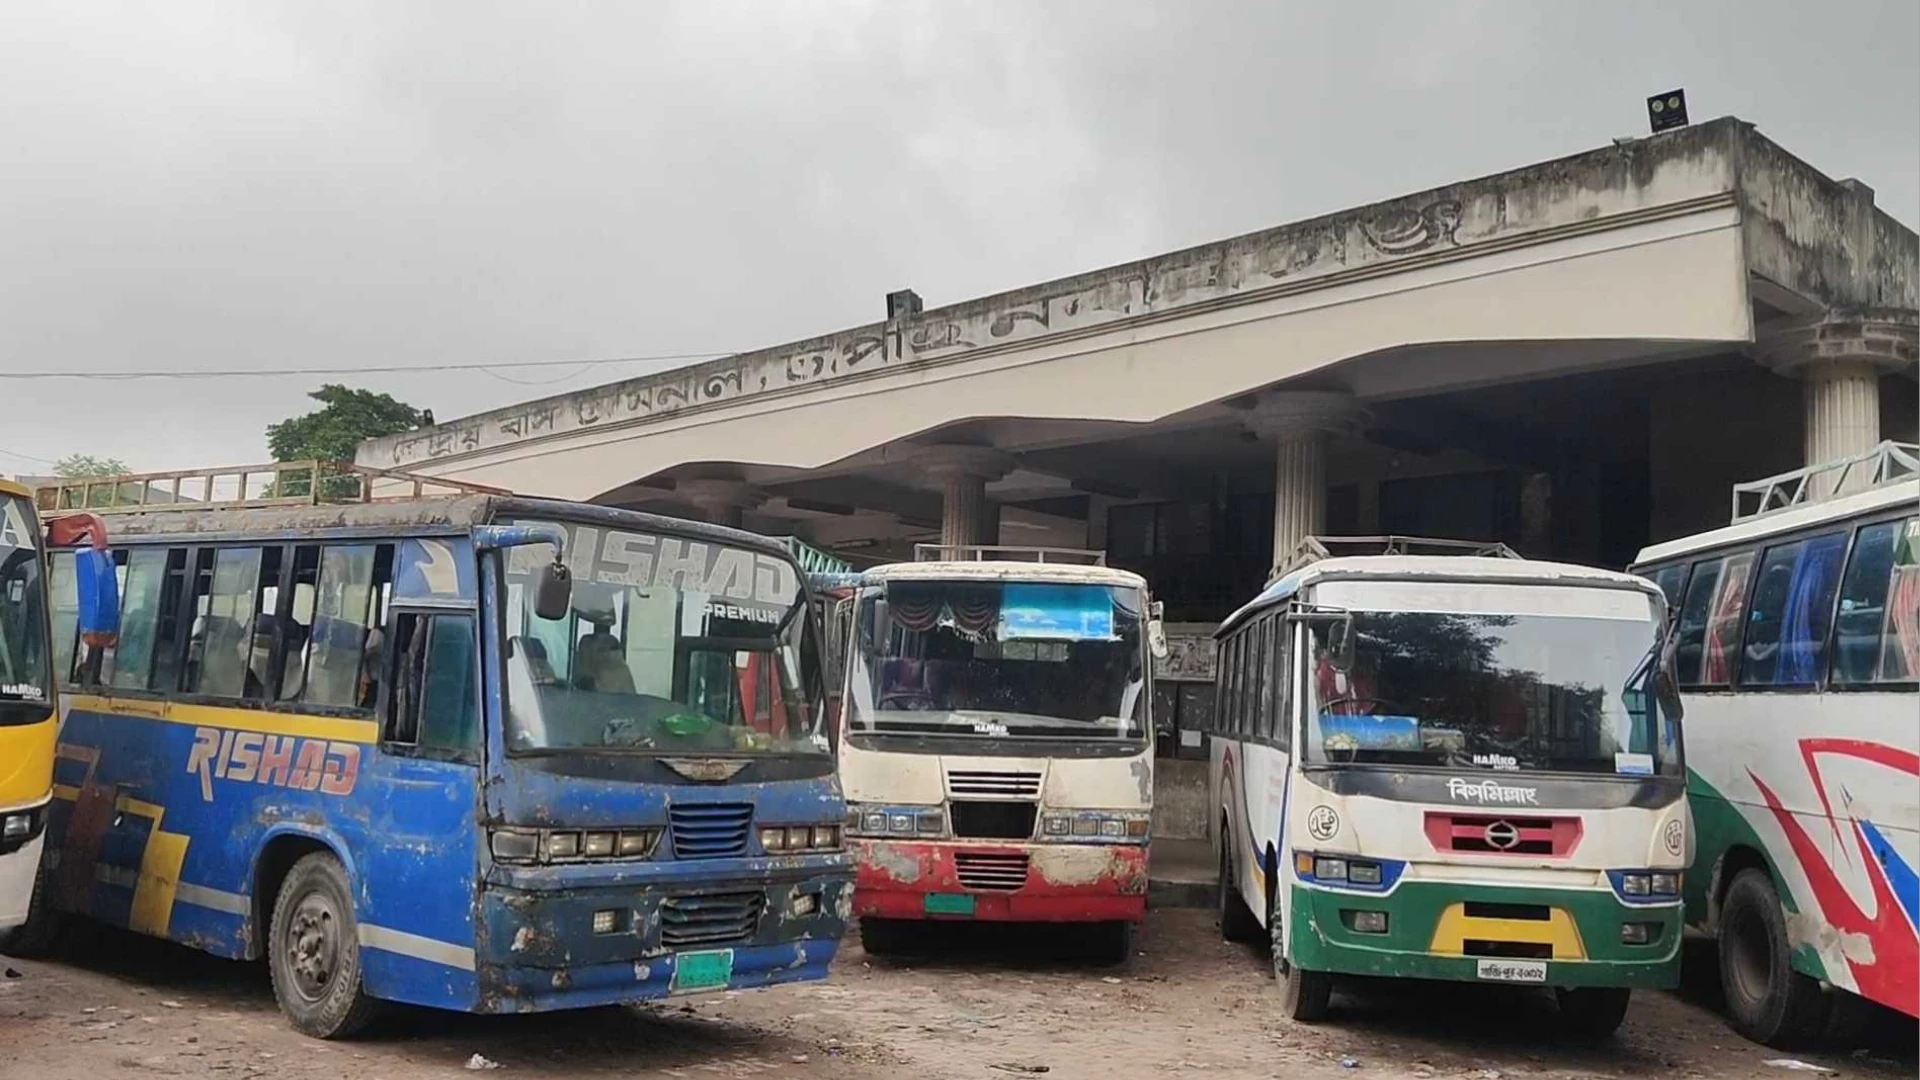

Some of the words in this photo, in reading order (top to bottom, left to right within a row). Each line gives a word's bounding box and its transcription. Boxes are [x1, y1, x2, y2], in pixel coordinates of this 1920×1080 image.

[702, 603, 780, 625] PREMIUM
[2, 683, 42, 697] HAMKO
[186, 727, 360, 802] RISHAD
[1473, 753, 1517, 765] HAMKO
